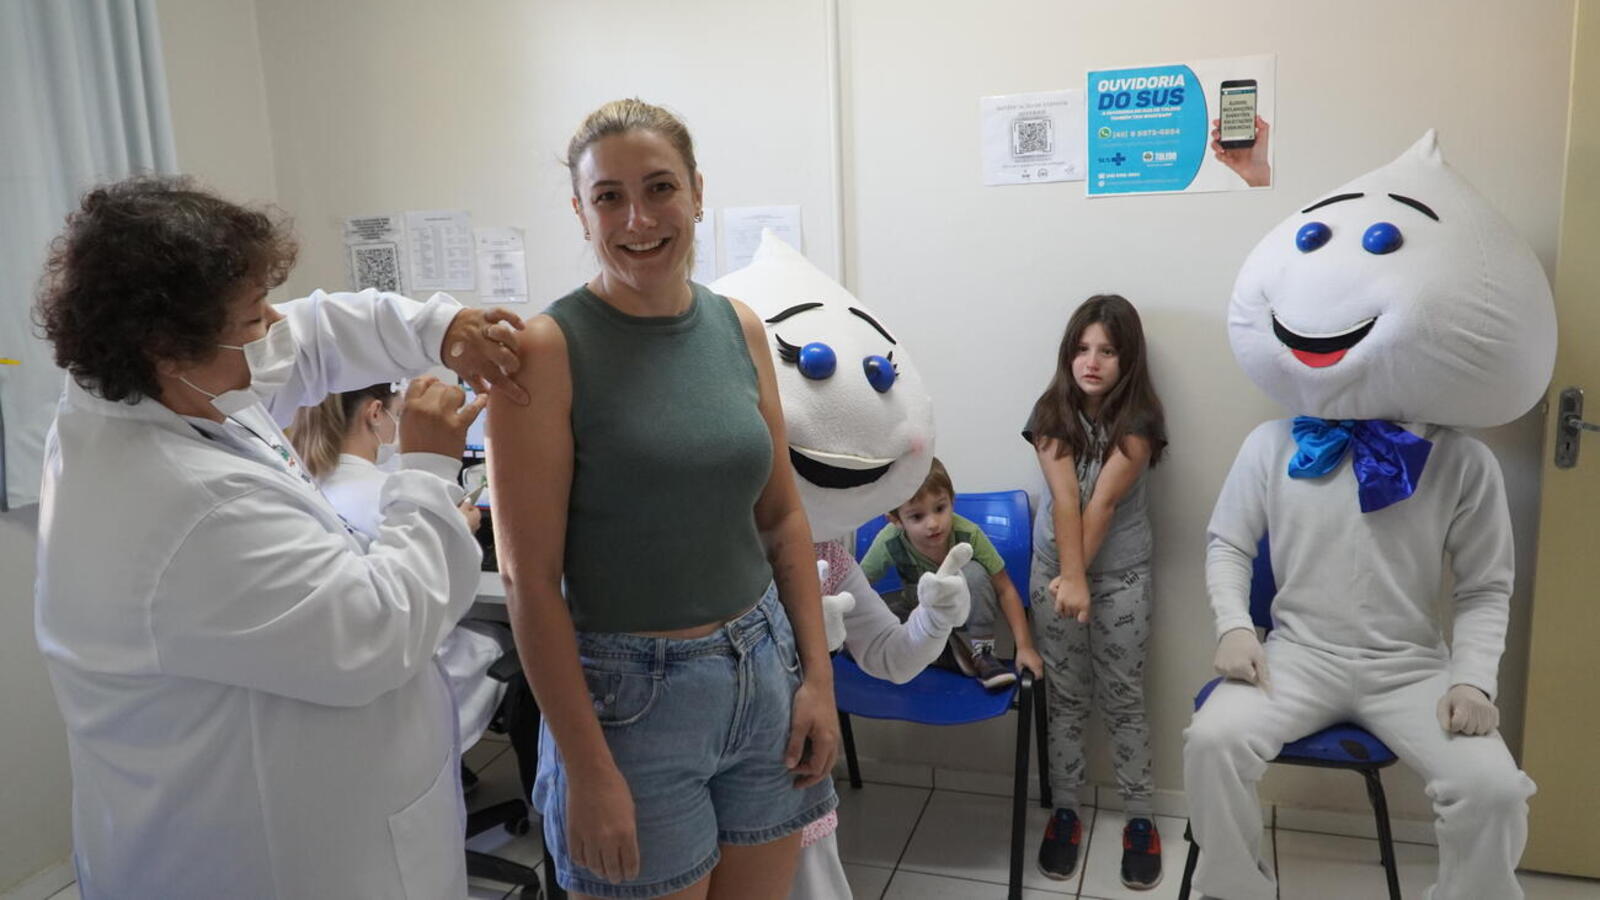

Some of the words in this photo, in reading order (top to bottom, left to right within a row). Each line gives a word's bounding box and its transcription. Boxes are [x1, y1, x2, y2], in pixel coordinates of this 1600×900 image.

[1098, 74, 1185, 92] OUVIDORIA
[1098, 91, 1131, 110] DO
[1136, 88, 1185, 107] SUS
